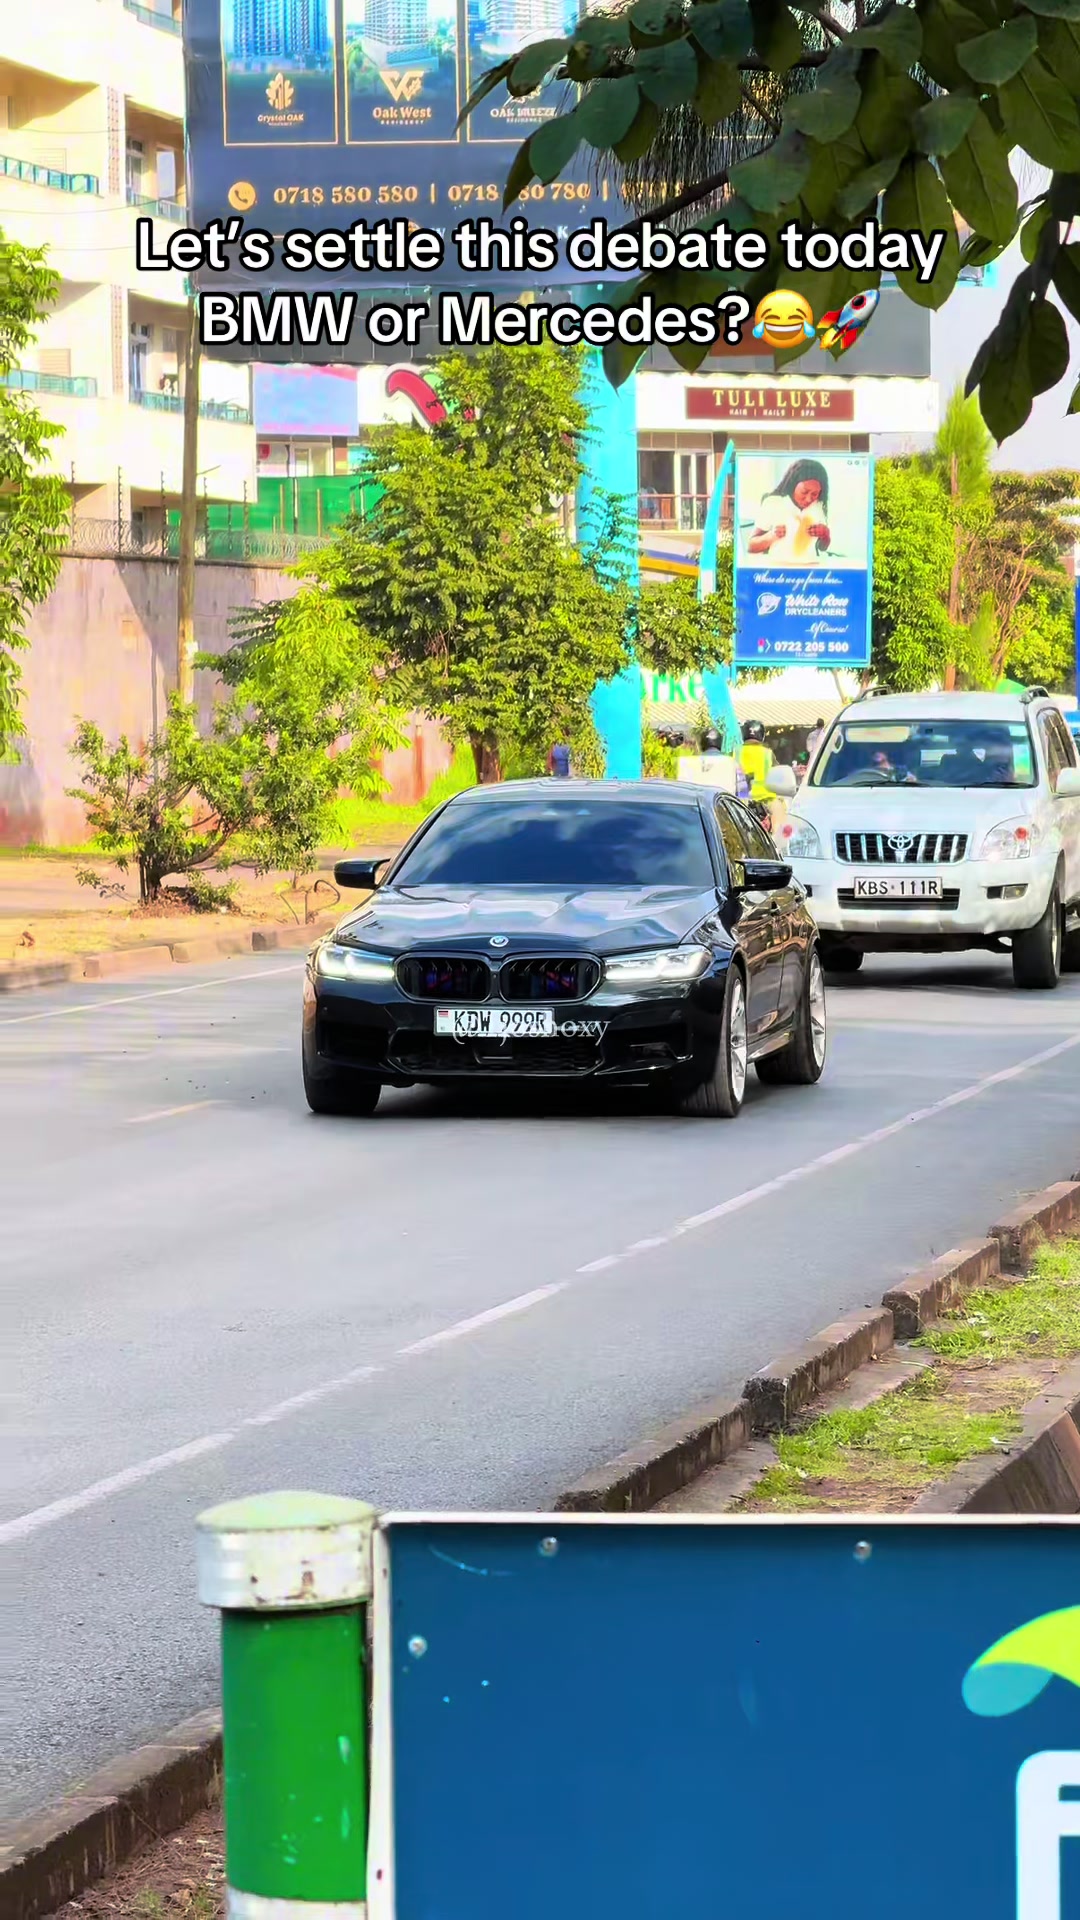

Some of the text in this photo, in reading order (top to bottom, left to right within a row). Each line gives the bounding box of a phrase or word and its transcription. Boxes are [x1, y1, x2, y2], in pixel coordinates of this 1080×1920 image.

[372, 106, 432, 120] Oak West
[490, 108, 514, 118] OAK
[273, 185, 325, 205] 0718
[331, 184, 372, 204] 580
[378, 183, 419, 204] 580
[447, 183, 499, 202] 0718
[550, 182, 593, 201] 780
[712, 389, 831, 408] TULI LUXE
[784, 608, 847, 616] DRYCLEANERS
[774, 641, 849, 652] 0722 205 500
[857, 880, 938, 895] KBS 111R
[453, 1010, 492, 1032] KDW
[499, 1011, 547, 1032] 999R
